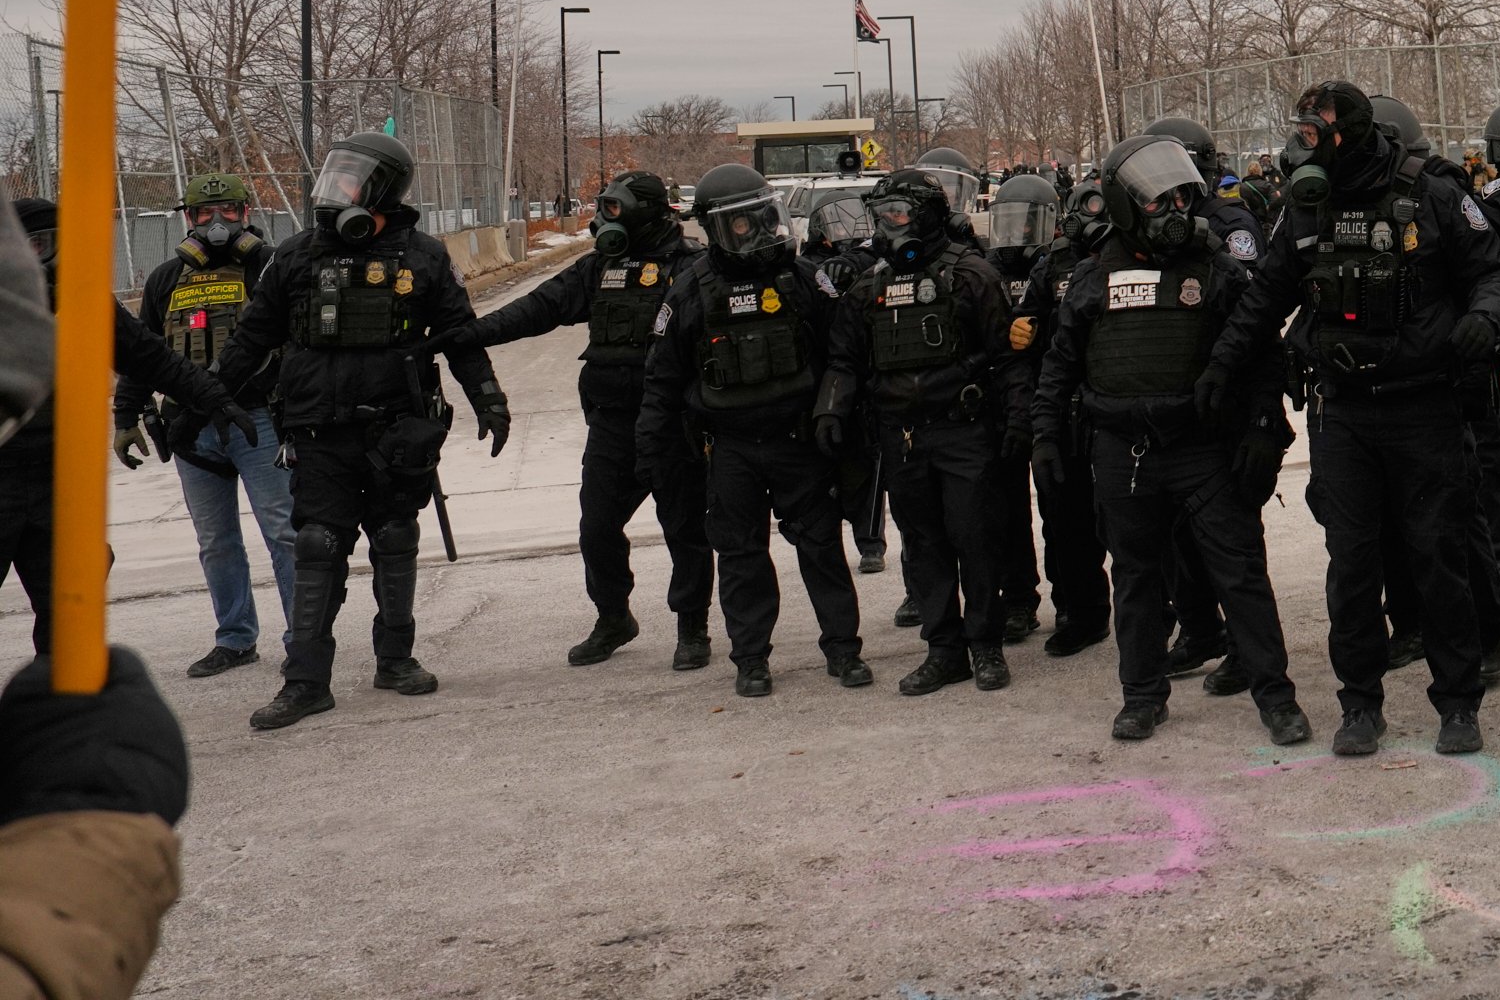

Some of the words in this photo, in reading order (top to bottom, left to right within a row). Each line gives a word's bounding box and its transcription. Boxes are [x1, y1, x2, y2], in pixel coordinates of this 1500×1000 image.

[1342, 211, 1364, 219] M-319
[1335, 222, 1367, 234] POLICE
[603, 269, 628, 280] POLICE
[175, 287, 205, 300] FEDERAL
[205, 285, 239, 295] OFFICER
[886, 282, 914, 298] POLICE
[1109, 284, 1156, 299] POLICE
[177, 297, 198, 307] BUREAU
[207, 294, 235, 302] PRISONS
[729, 293, 757, 307] POLICE
